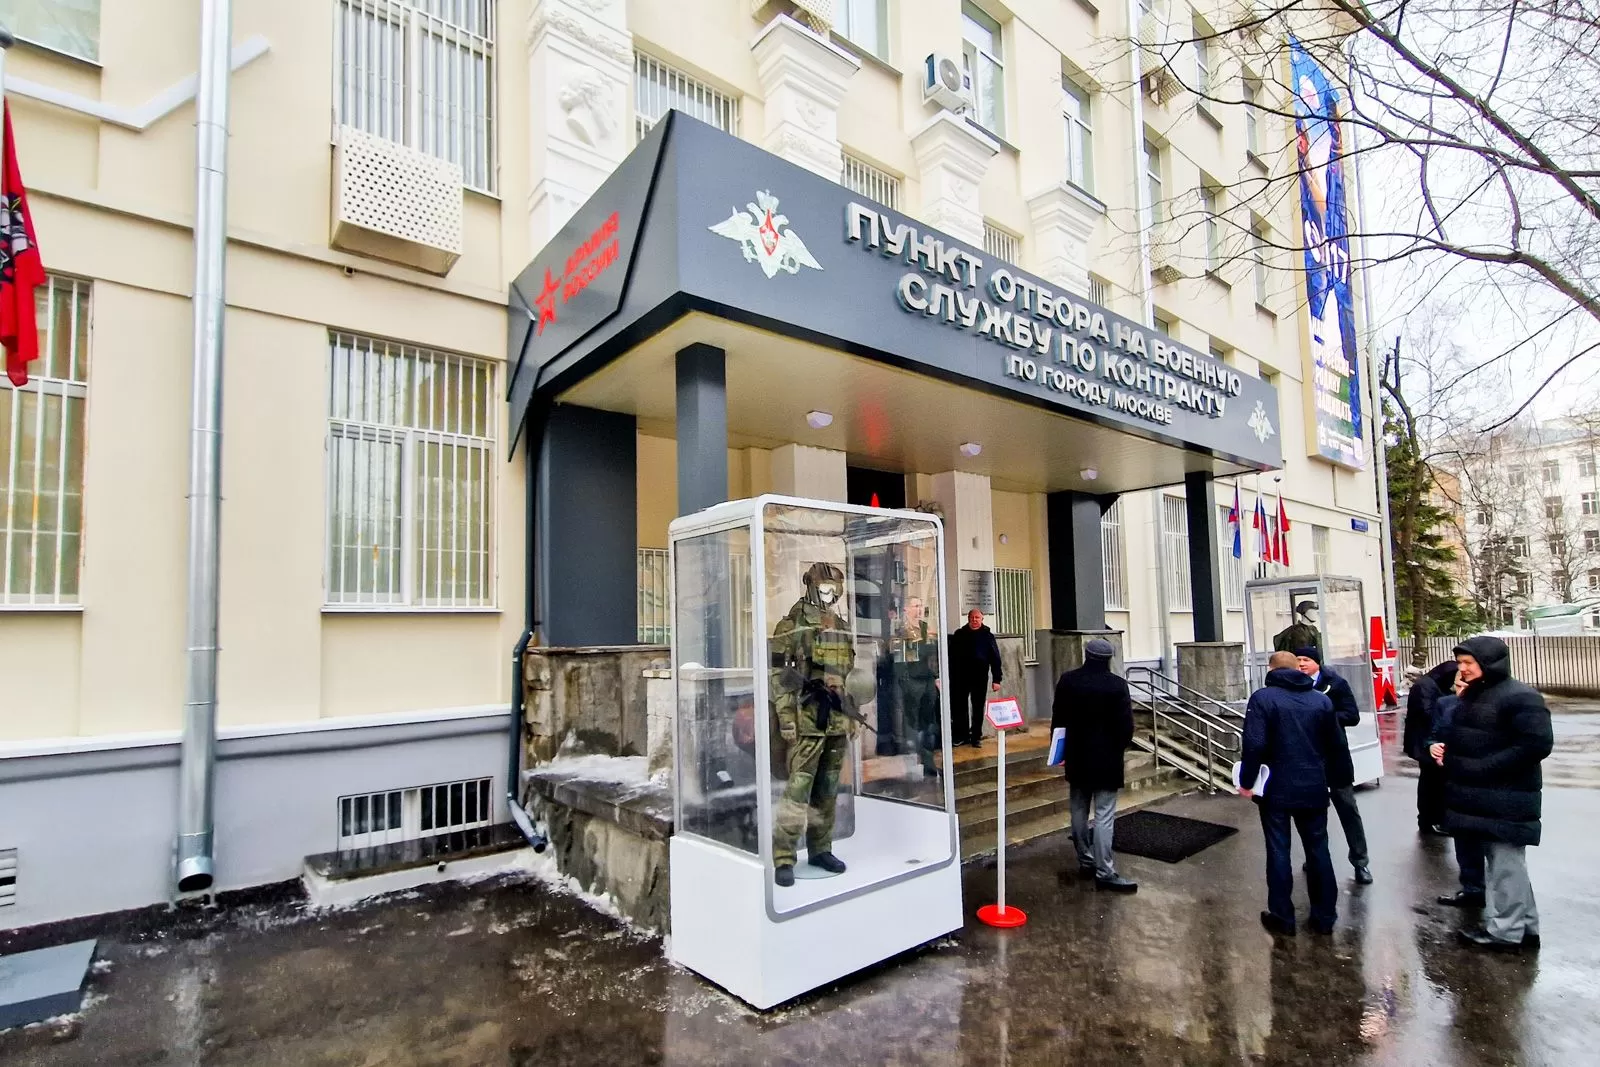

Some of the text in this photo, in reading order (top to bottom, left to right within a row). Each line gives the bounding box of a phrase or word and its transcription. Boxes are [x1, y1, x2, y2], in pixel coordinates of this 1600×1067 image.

[846, 201, 983, 289] ПУНКТ
[988, 268, 1110, 344] ОТБОРА
[1112, 322, 1148, 360] НА
[1152, 338, 1242, 398] ВОЕННУЮ
[897, 272, 1226, 418] СЛУЖБУ ПО КОНТРАКТУ
[1006, 354, 1173, 425] ПО ГОРОДУ МОСКВЕ
